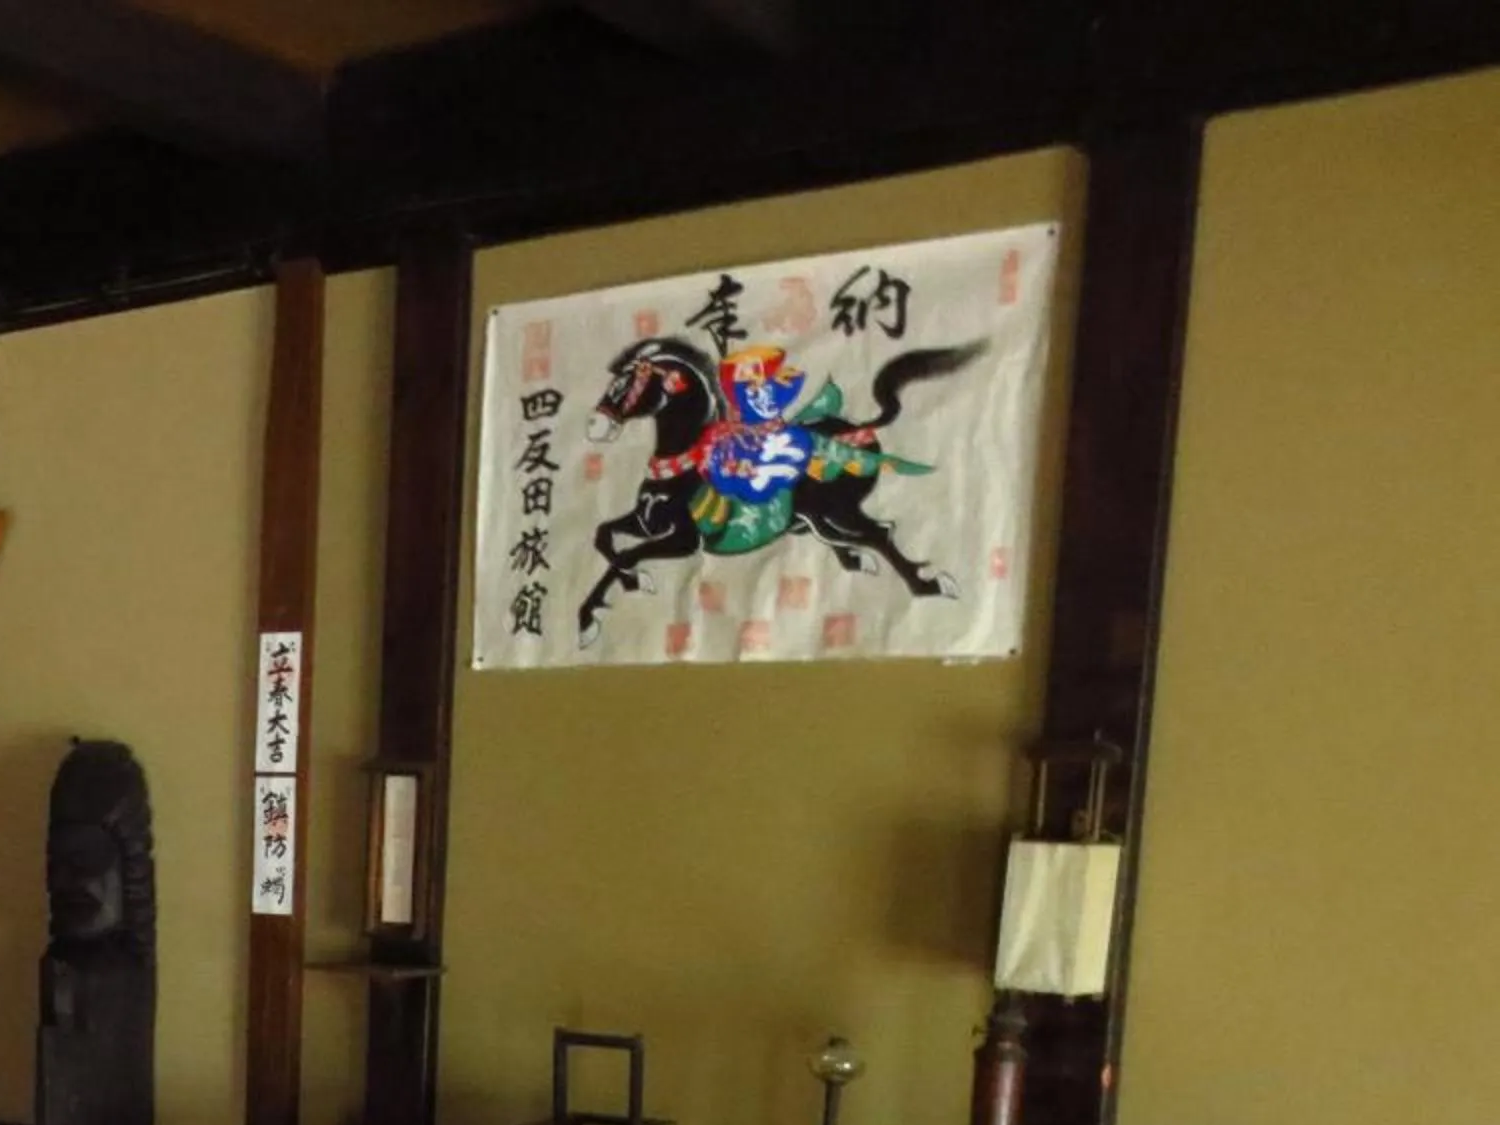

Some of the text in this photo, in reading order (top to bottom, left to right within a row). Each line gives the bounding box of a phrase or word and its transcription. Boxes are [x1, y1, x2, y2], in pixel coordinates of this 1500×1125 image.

[510, 388, 564, 635] 四反田旅館
[266, 641, 294, 764] 立春大吉
